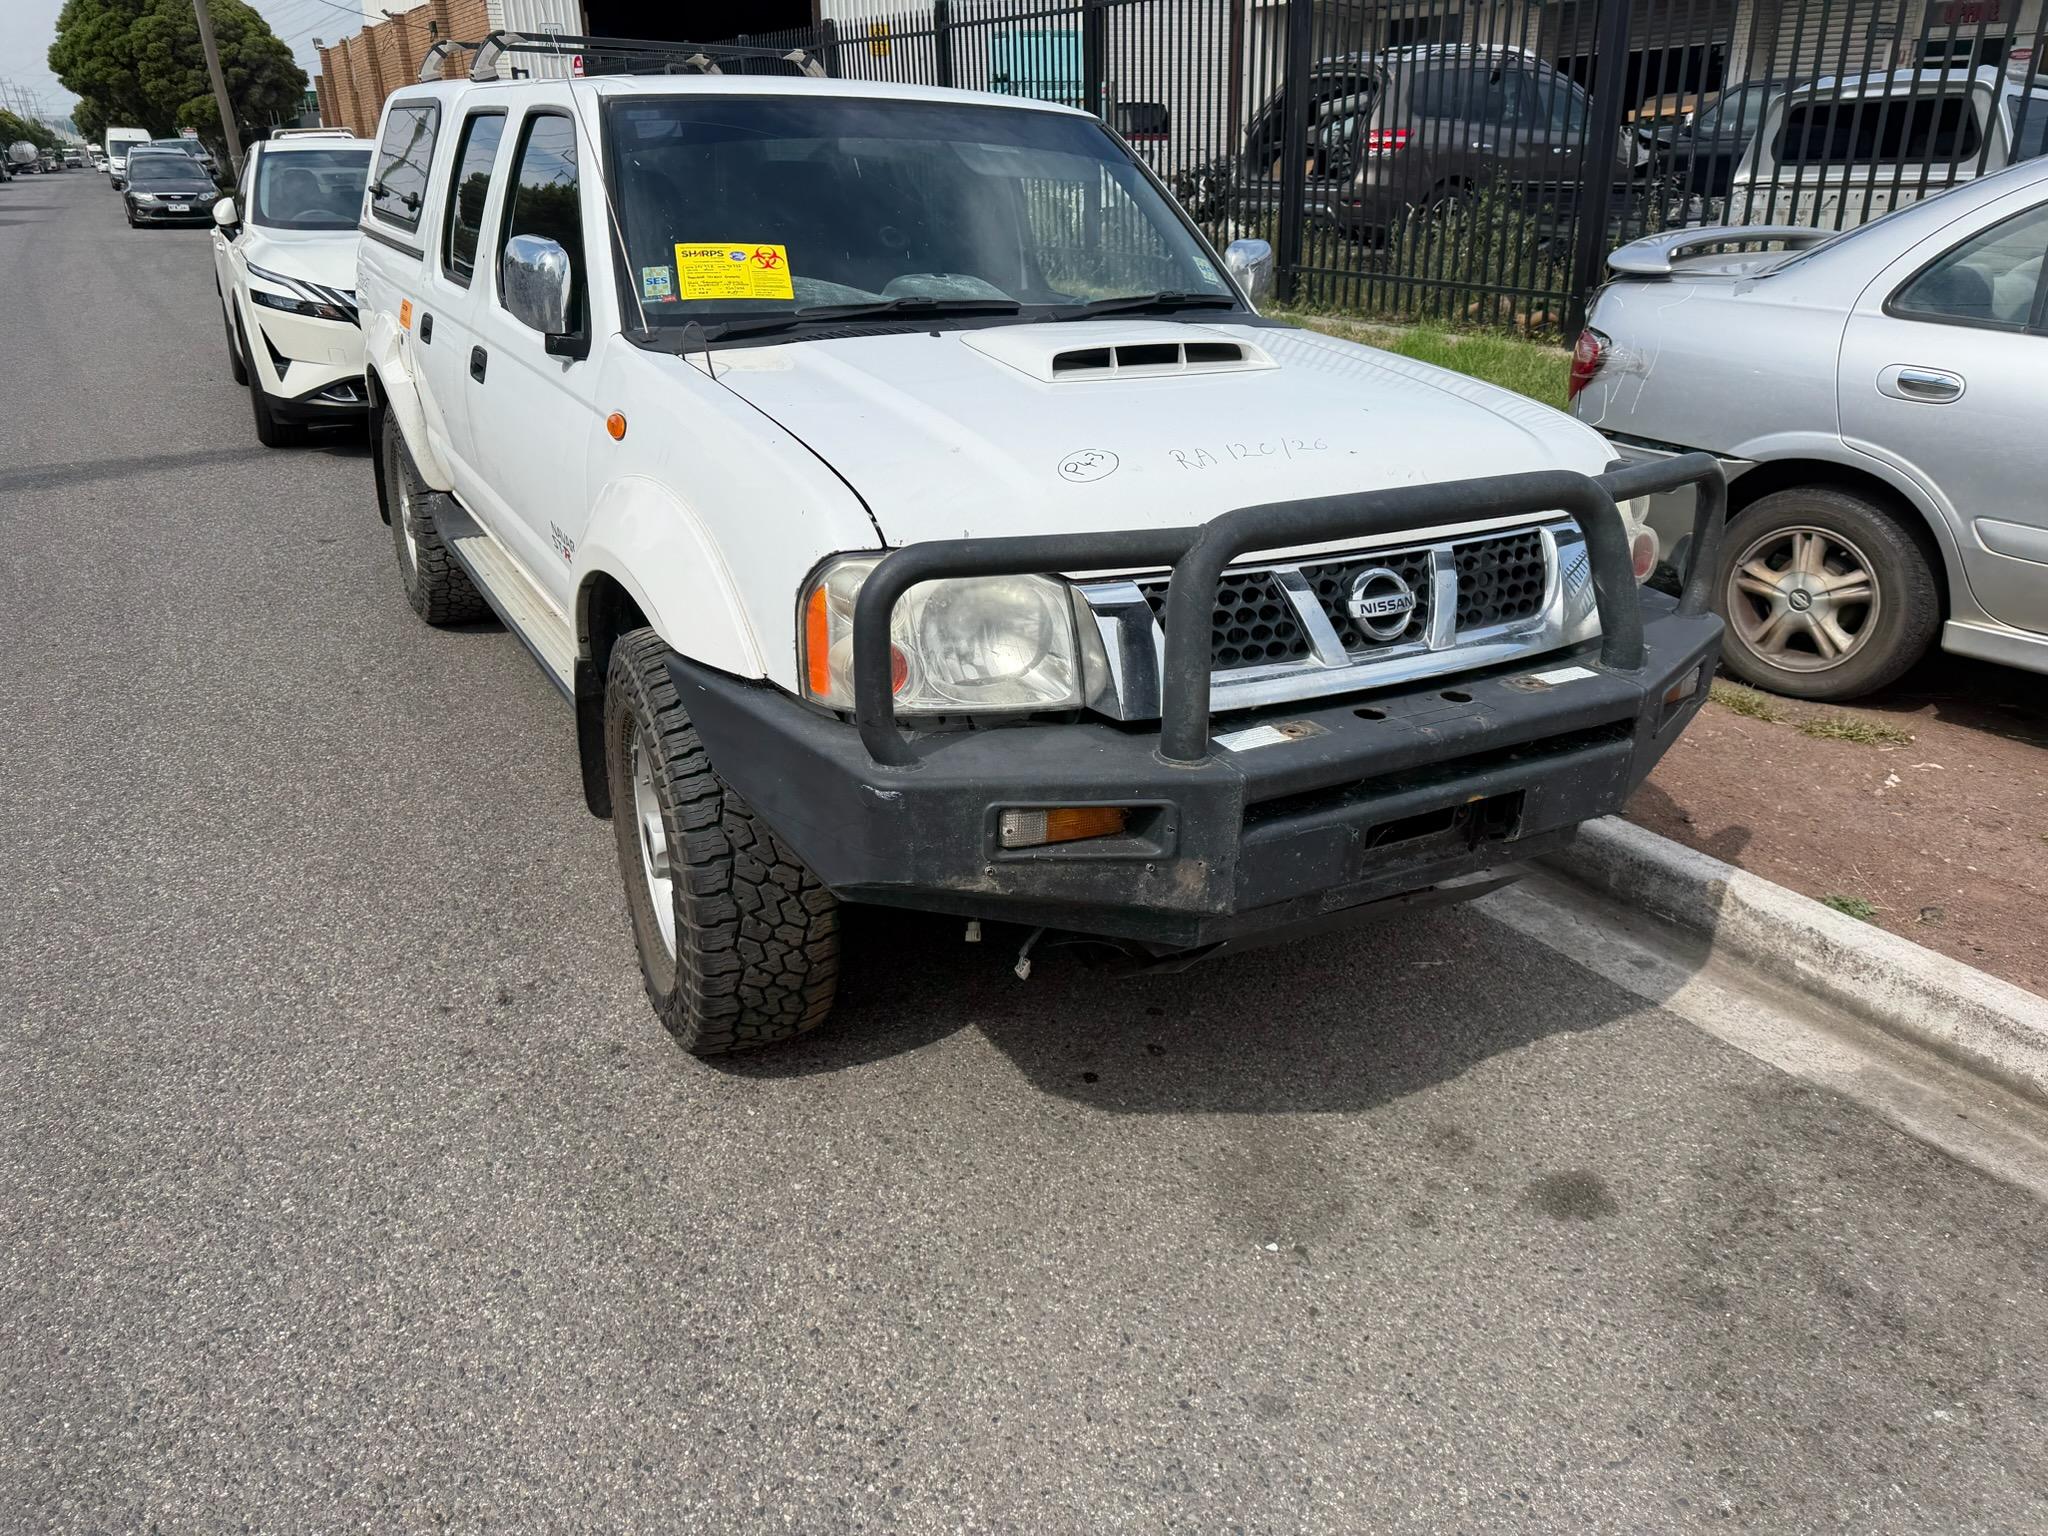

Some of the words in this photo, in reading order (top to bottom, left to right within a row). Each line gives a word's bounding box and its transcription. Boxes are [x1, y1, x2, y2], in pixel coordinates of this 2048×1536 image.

[681, 250, 724, 258] SHARPS
[646, 277, 668, 285] SES
[1360, 595, 1412, 615] NISSAN
